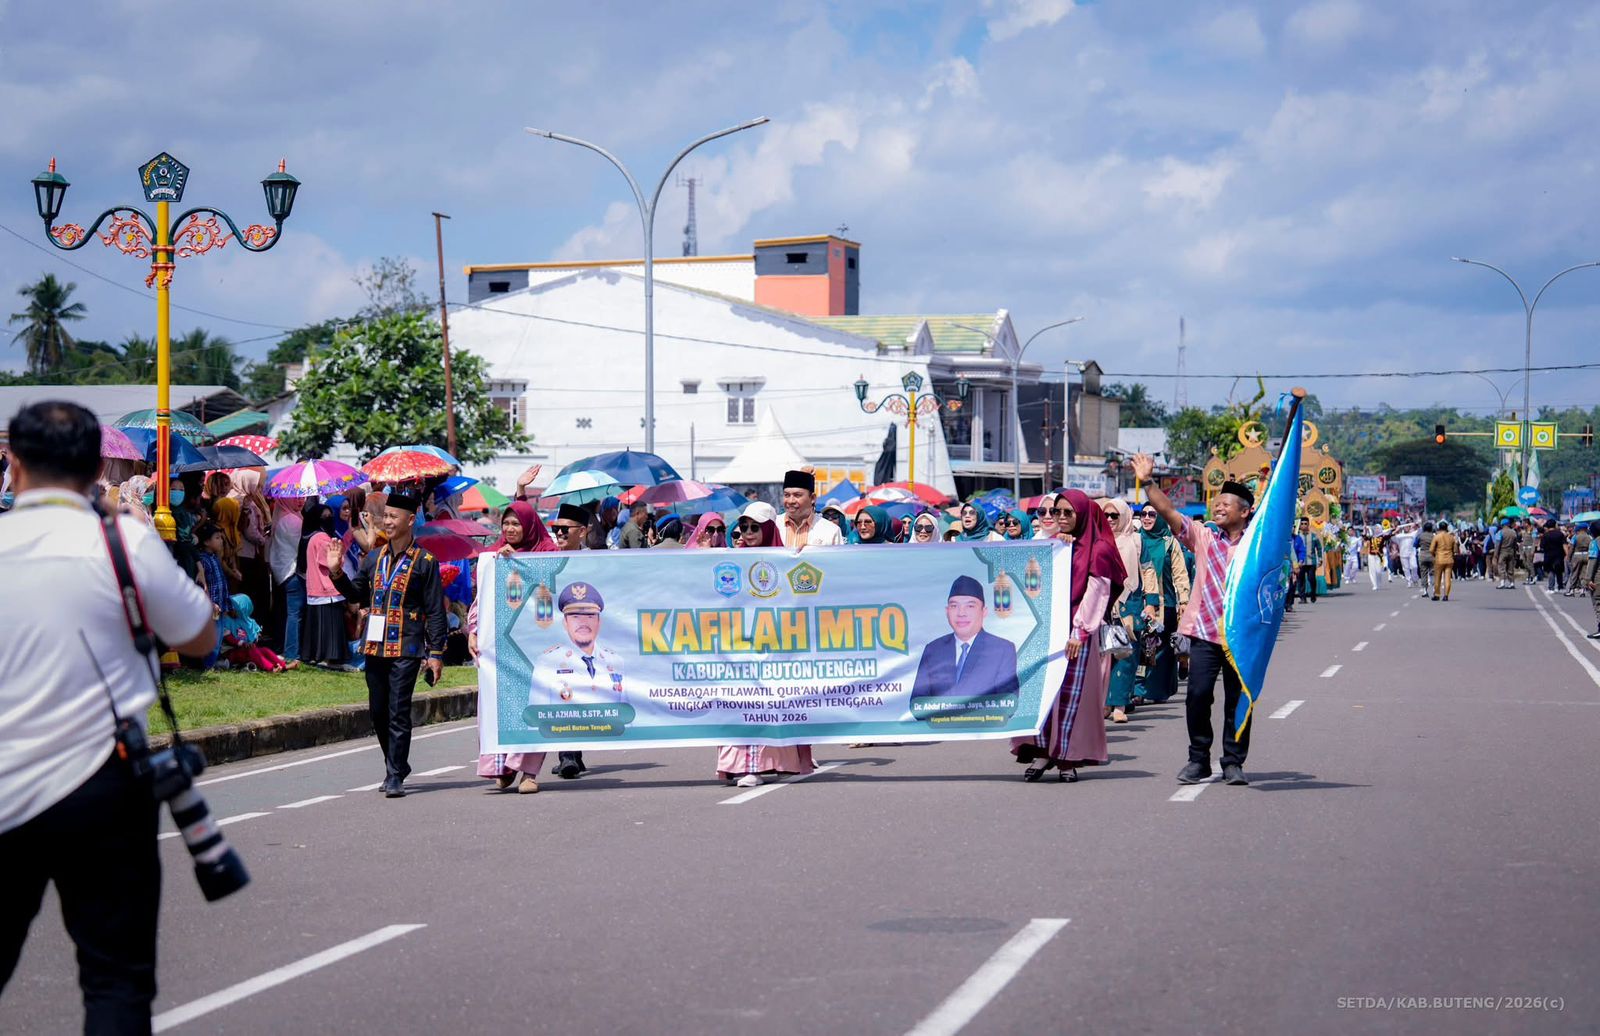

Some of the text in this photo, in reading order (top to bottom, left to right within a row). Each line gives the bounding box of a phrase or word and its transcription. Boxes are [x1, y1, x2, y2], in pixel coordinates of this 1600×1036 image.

[640, 604, 908, 653] KAFILAH MTQ
[673, 659, 876, 680] KABUPATEN BUTON TENGAH
[649, 683, 902, 699] MUSABAQAH TILAWATIL QUR'AN (MTQ) KE XXXI
[668, 697, 884, 712] TINGKAT PROVINSI SULAWESI TENGGARA
[743, 713, 808, 723] TAHUN 2026
